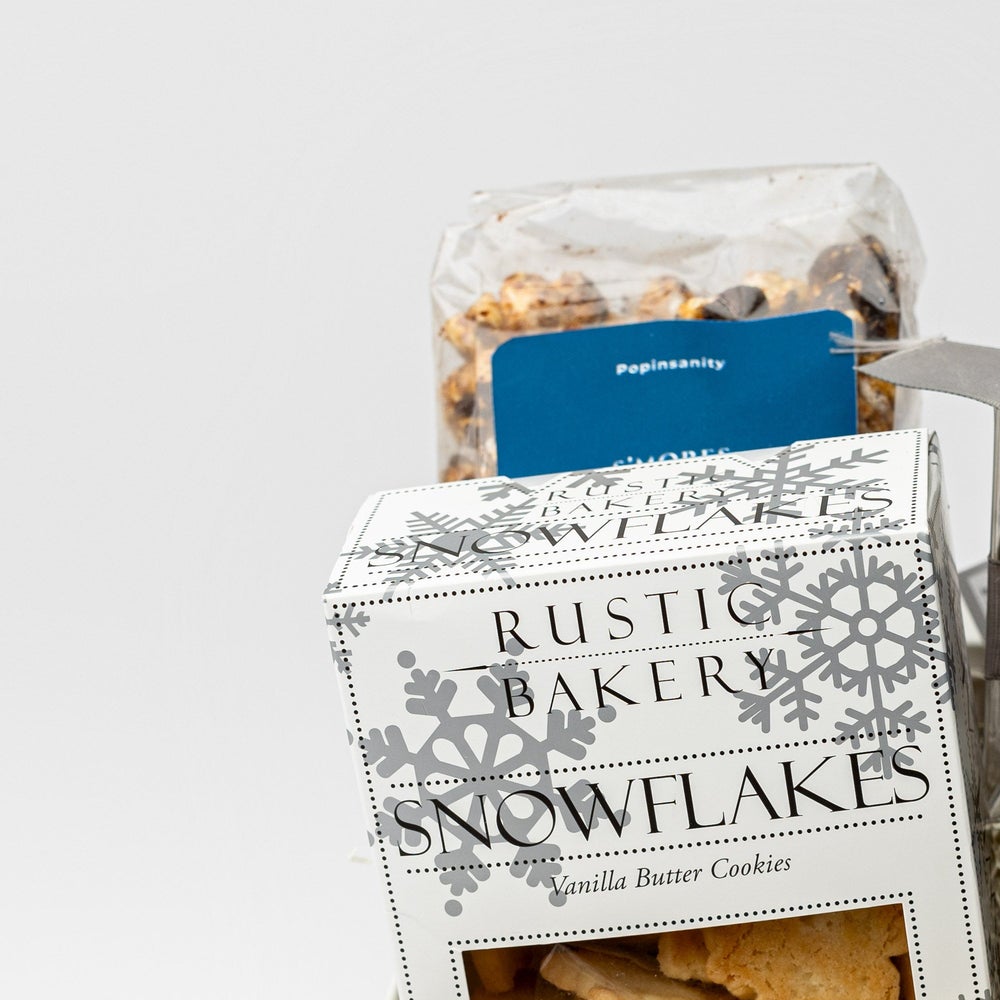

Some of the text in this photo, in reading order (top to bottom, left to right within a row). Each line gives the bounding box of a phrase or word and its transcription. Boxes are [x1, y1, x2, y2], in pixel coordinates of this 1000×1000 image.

[615, 356, 726, 376] Popinsanity
[540, 485, 733, 518] BAKERY
[546, 473, 725, 501] RUSTIC
[366, 488, 894, 567] SNOWFLAKES
[492, 581, 772, 653] RUSTIC
[502, 647, 777, 719] BAKERY
[392, 744, 931, 857] SNOWFLAKES
[549, 852, 793, 896] Vanilla Butter Cookies
